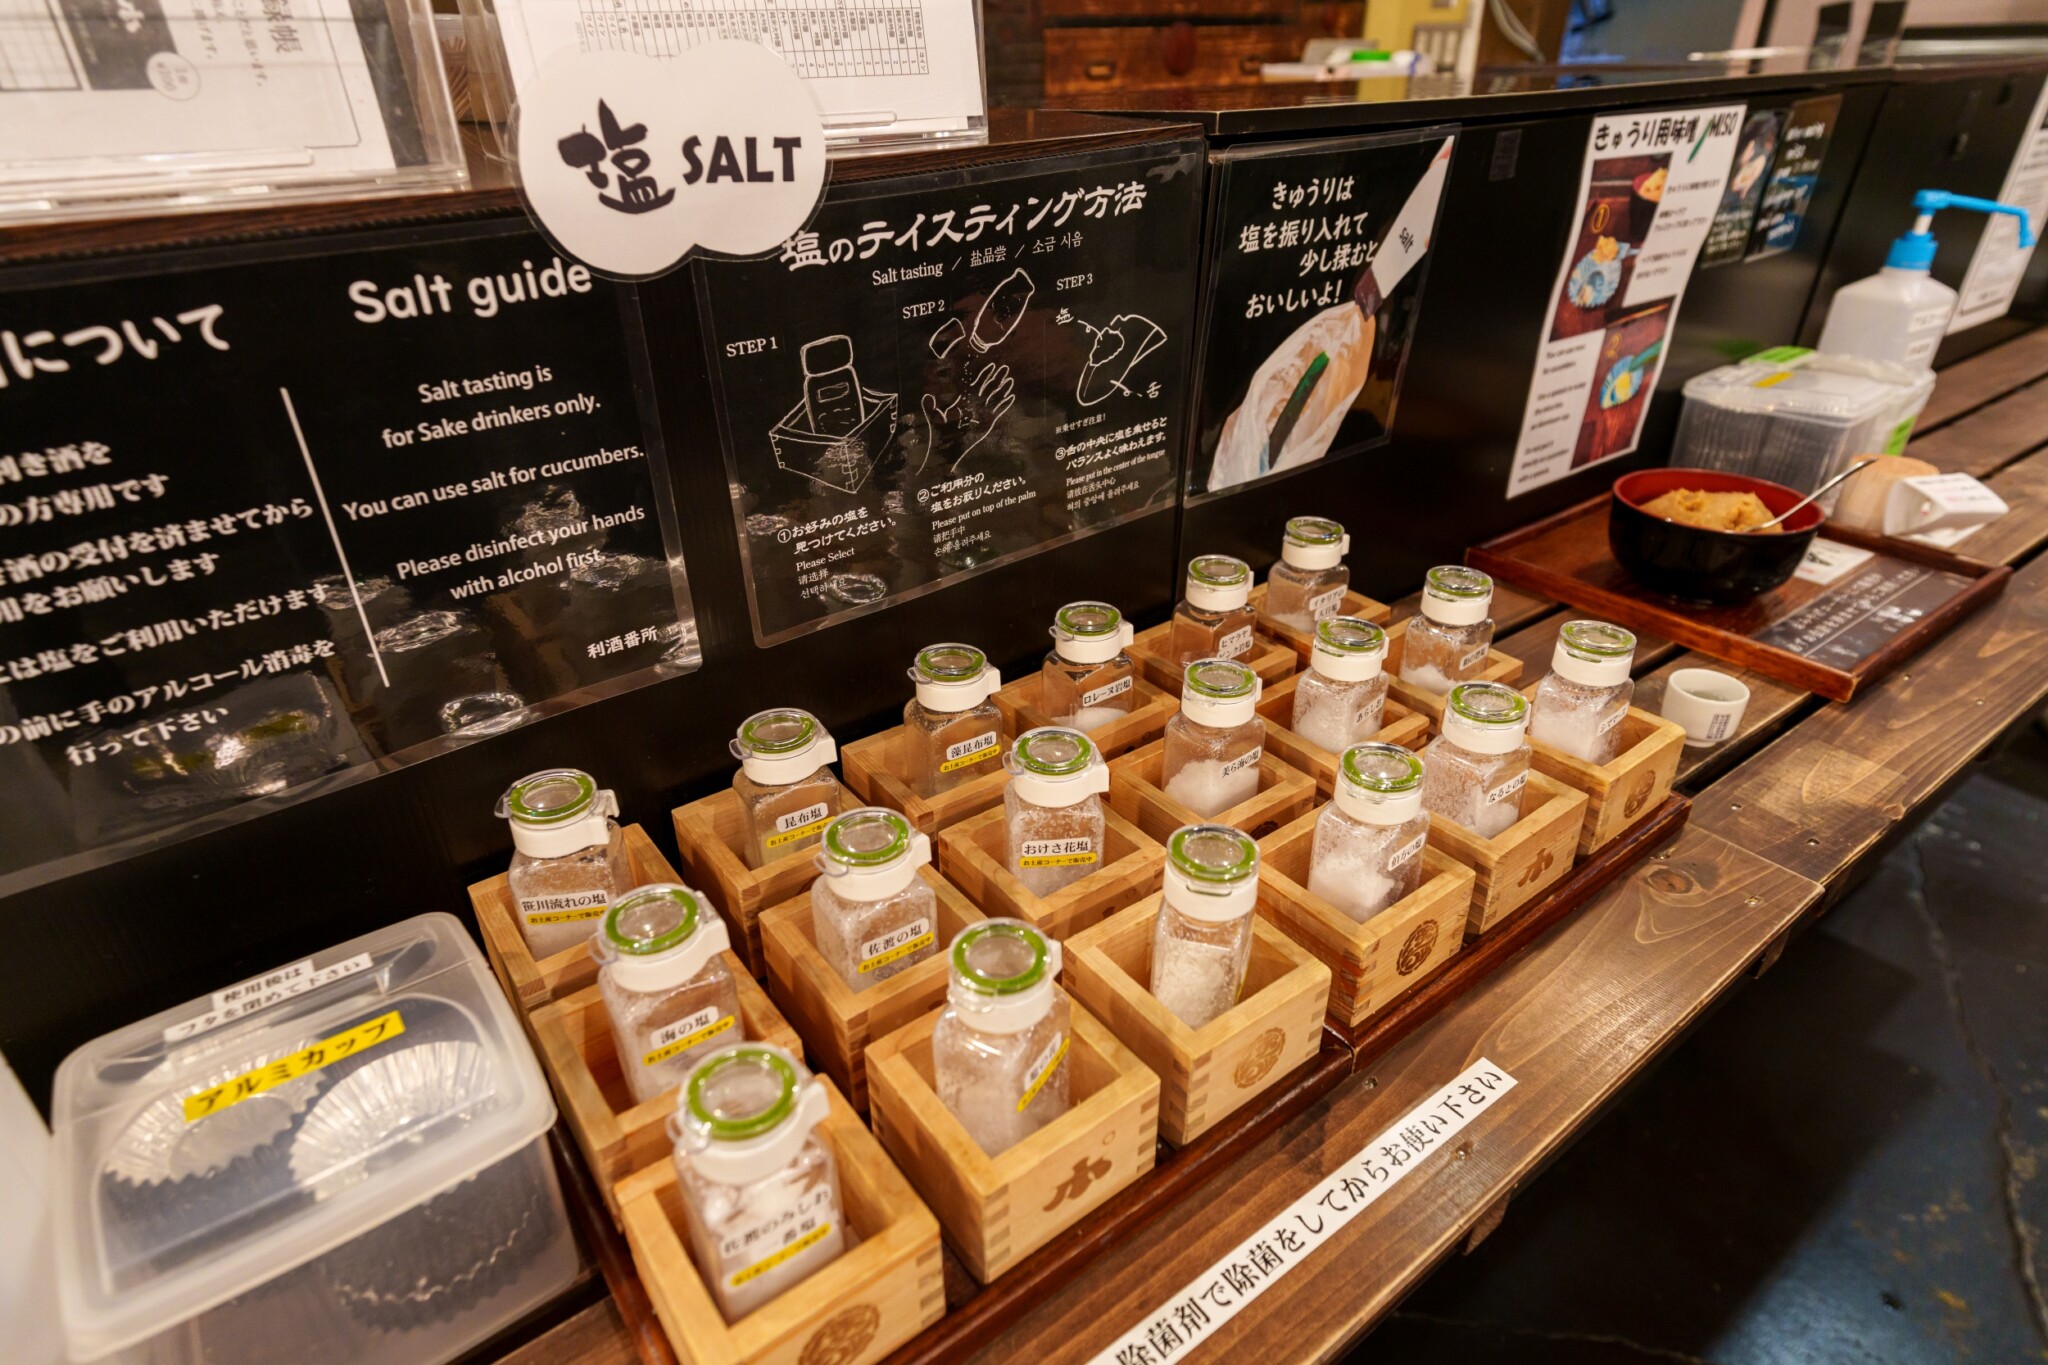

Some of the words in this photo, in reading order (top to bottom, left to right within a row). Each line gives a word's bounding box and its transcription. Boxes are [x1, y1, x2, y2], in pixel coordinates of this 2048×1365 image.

[1707, 111, 1739, 138] MISO
[682, 134, 803, 185] SALT
[1272, 174, 1356, 211] きゅうりは
[1238, 211, 1369, 254] 塩を振り入れて
[871, 267, 899, 286] Salt
[900, 262, 944, 283] tasting
[1032, 236, 1057, 254] 소금
[1299, 239, 1380, 278] 少し揉むと
[349, 273, 453, 324] Salt
[467, 256, 593, 318] guide
[1056, 274, 1087, 291] STEP
[1087, 273, 1094, 285] 3
[902, 301, 936, 319] STEP
[936, 299, 946, 313] 2
[0, 304, 230, 389] について
[726, 338, 768, 358] STEP
[770, 336, 779, 350] 1
[418, 379, 461, 404] Salt
[462, 368, 534, 398] tasting
[535, 364, 553, 382] is
[381, 427, 415, 449] for
[418, 416, 469, 442] Sake
[471, 405, 552, 432] drinkers
[554, 393, 601, 420] only.
[342, 500, 389, 521] You
[391, 491, 430, 511] can
[433, 481, 468, 502] use
[472, 470, 508, 493] salt
[508, 466, 537, 485] for
[540, 445, 645, 477] cucumbers.
[1066, 475, 1086, 487] Please
[1086, 471, 1096, 482] put
[1102, 466, 1113, 476] the
[1113, 461, 1130, 472] center
[1136, 454, 1146, 464] the
[0, 473, 169, 526] の方専用です
[932, 517, 957, 530] Please
[958, 511, 971, 524] put
[971, 508, 982, 517] on
[982, 503, 995, 513] top
[995, 498, 1004, 509] of
[1004, 495, 1017, 507] the
[1017, 489, 1037, 503] palm
[0, 497, 313, 586] 酒の受付を済ませてから
[396, 552, 463, 580] Please
[465, 530, 546, 563] disinfect
[548, 520, 589, 546] your
[591, 504, 645, 531] hands
[793, 517, 897, 555] 見つけてください。
[449, 577, 494, 600] with
[498, 557, 564, 588] alcohol
[565, 547, 606, 569] first.
[795, 556, 827, 572] Please
[828, 546, 856, 563] Select
[586, 624, 658, 659] 利酒番所
[1222, 630, 1248, 648] ヒマラヤ
[1084, 679, 1131, 706] ロレーヌ岩塩
[66, 706, 229, 767] 行って下さい
[943, 748, 998, 772] お土産コーナーで販売中
[1221, 749, 1260, 778] 美ら海の塩
[1489, 773, 1527, 803] なるとの塩
[784, 807, 823, 830] 昆布塩
[1023, 855, 1093, 867] お土産コーナーで販売中
[1024, 840, 1089, 855] おけさ花塩
[522, 893, 607, 912] 笹川流れの塩
[868, 923, 923, 956] 佐渡の塩
[196, 1017, 391, 1114] アルミカップ
